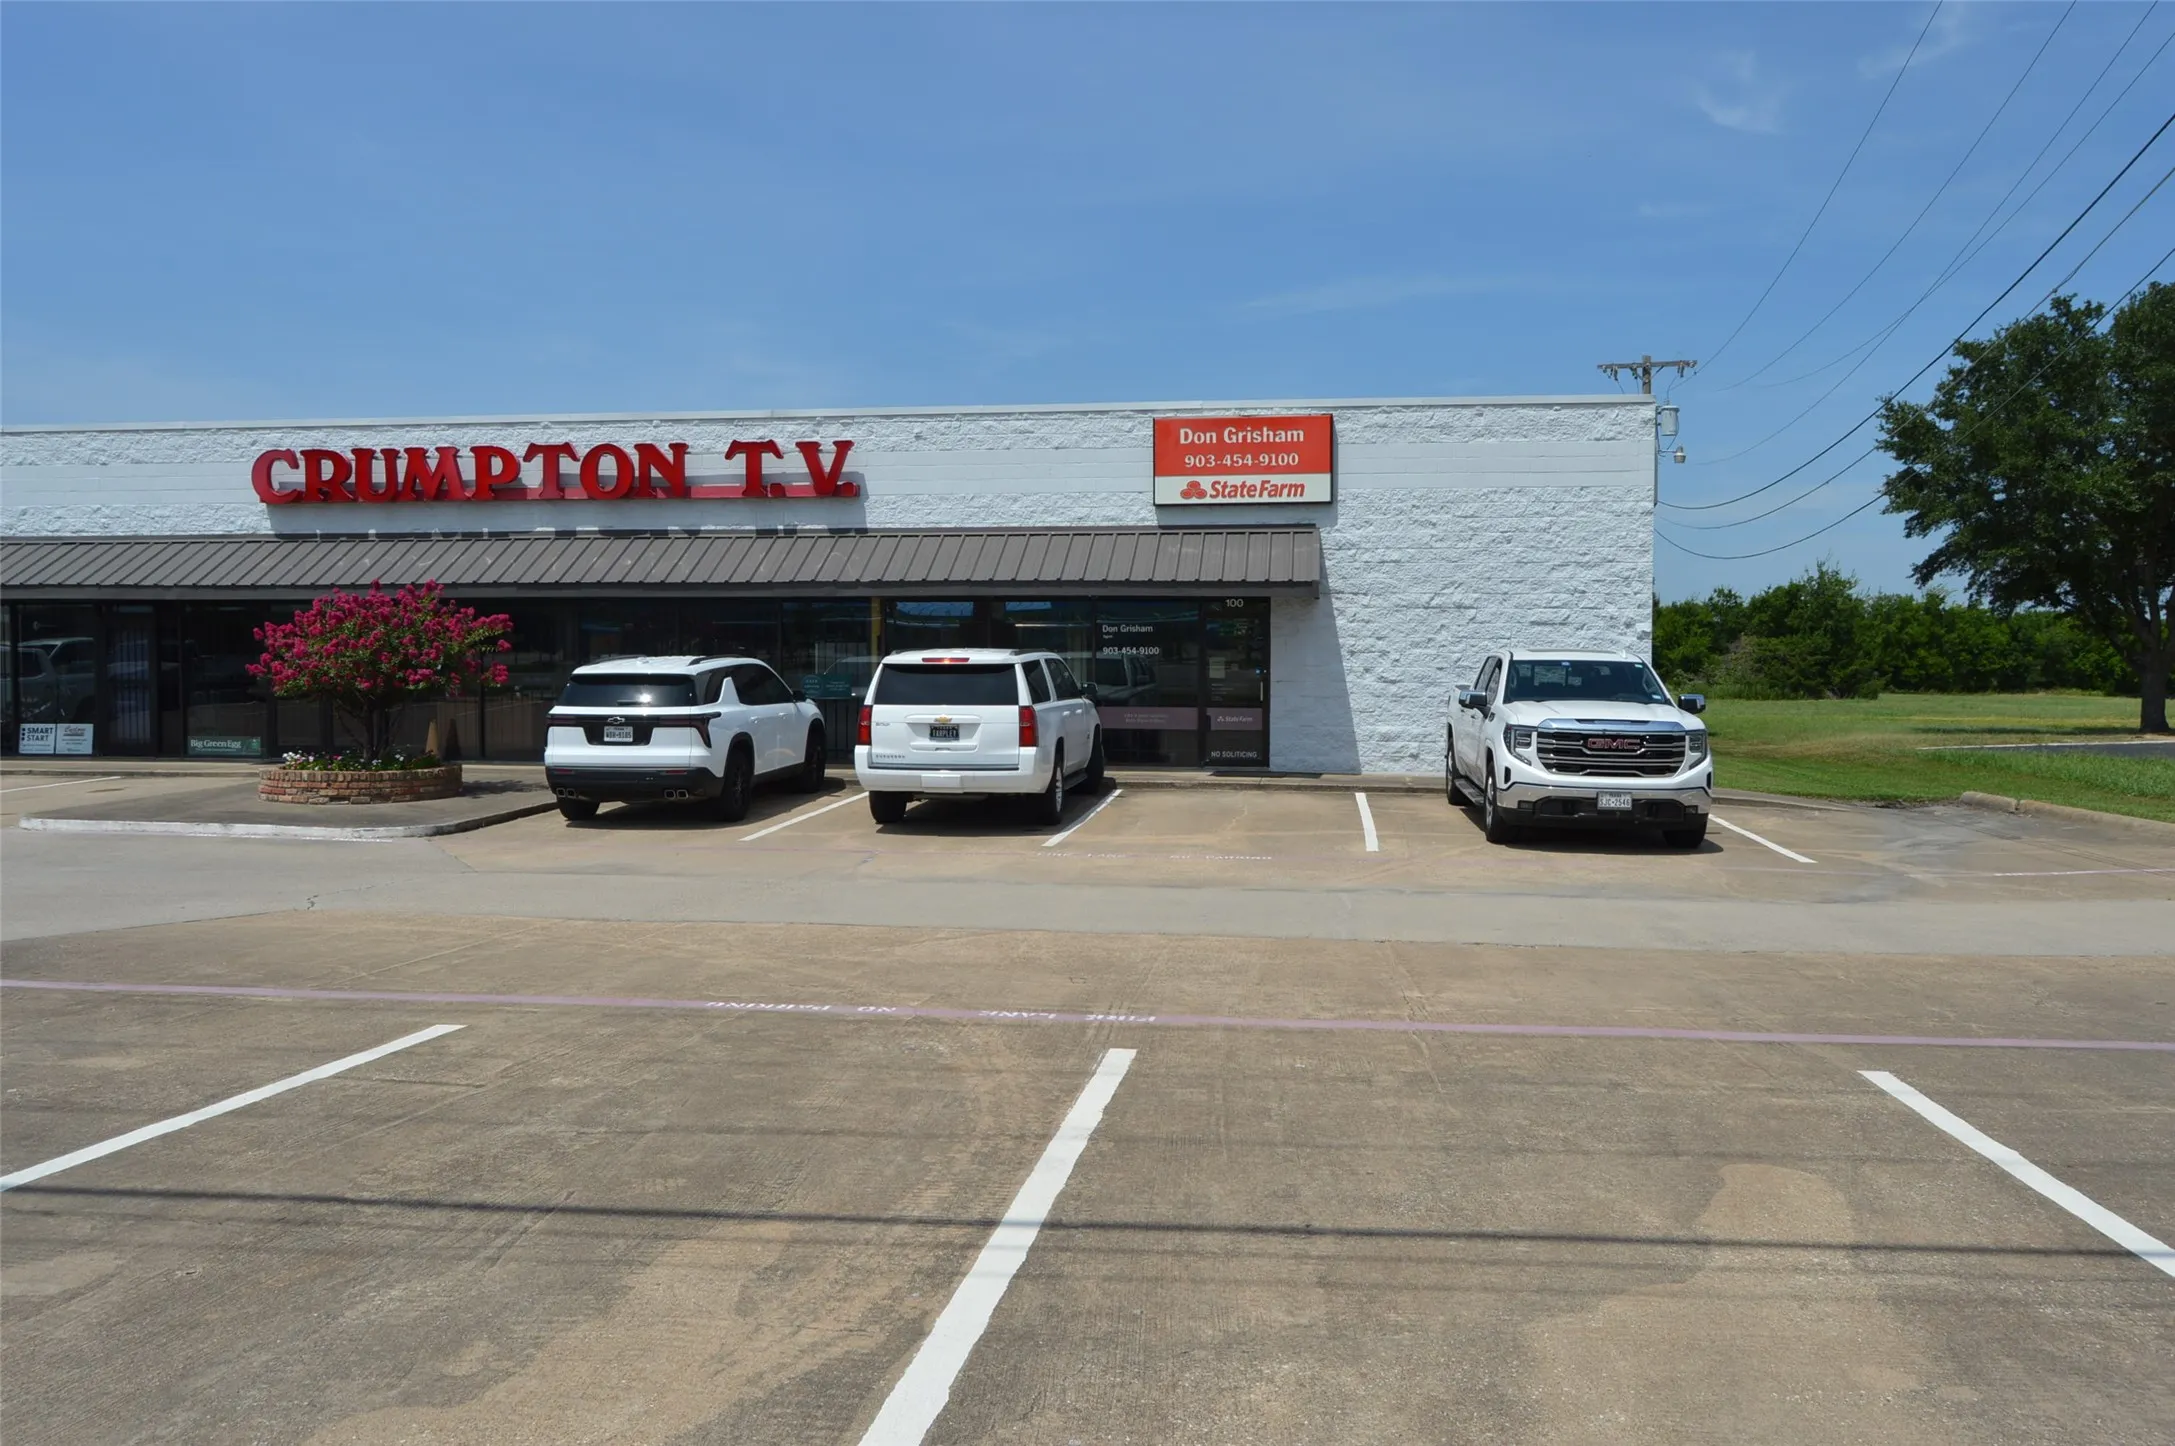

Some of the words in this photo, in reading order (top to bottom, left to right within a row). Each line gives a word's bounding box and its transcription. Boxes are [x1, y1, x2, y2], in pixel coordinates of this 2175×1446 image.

[1179, 427, 1217, 444] Don
[1223, 426, 1304, 444] Grisham
[1184, 452, 1299, 468] 903-454-9100
[251, 441, 690, 504] CRUMPTON
[725, 439, 860, 498] T.V.
[1225, 599, 1244, 608] 100
[1102, 624, 1118, 633] Don
[1120, 624, 1154, 633] Grisham
[1102, 646, 1160, 655] 903-454-9100
[27, 727, 54, 735] SMART
[190, 739, 203, 748] Big
[203, 739, 227, 748] Green
[227, 739, 242, 748] Egg
[1587, 738, 1640, 749] GMC
